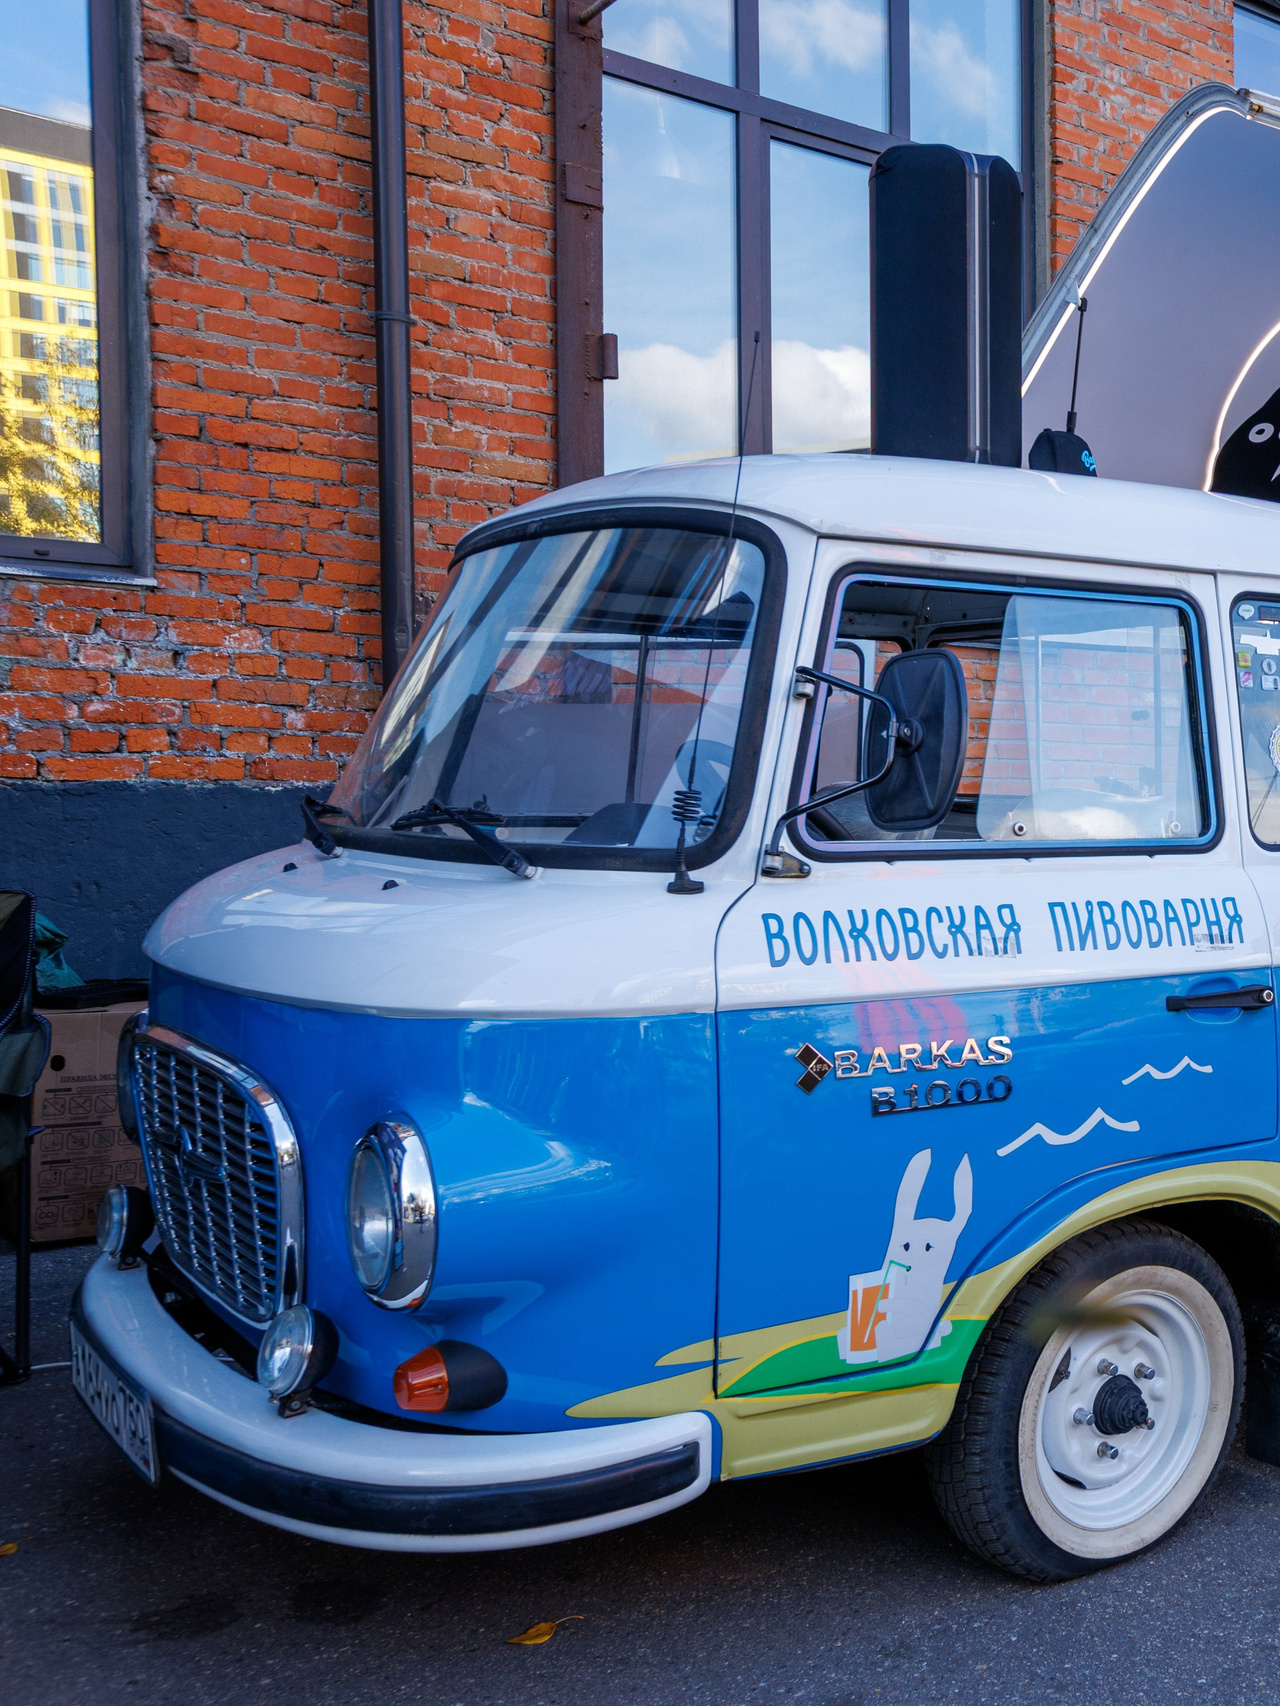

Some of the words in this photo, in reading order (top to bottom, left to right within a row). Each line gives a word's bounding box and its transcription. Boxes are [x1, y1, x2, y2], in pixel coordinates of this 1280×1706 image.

[761, 903, 1022, 968] ВОЛКОВСКАЯ
[1048, 896, 1245, 953] ПИВОВАРНЯ
[60, 1074, 97, 1083] ПРАВИЛА
[812, 1063, 829, 1072] IFA
[834, 1035, 1013, 1080] BARKAS
[870, 1074, 1014, 1117] B1000
